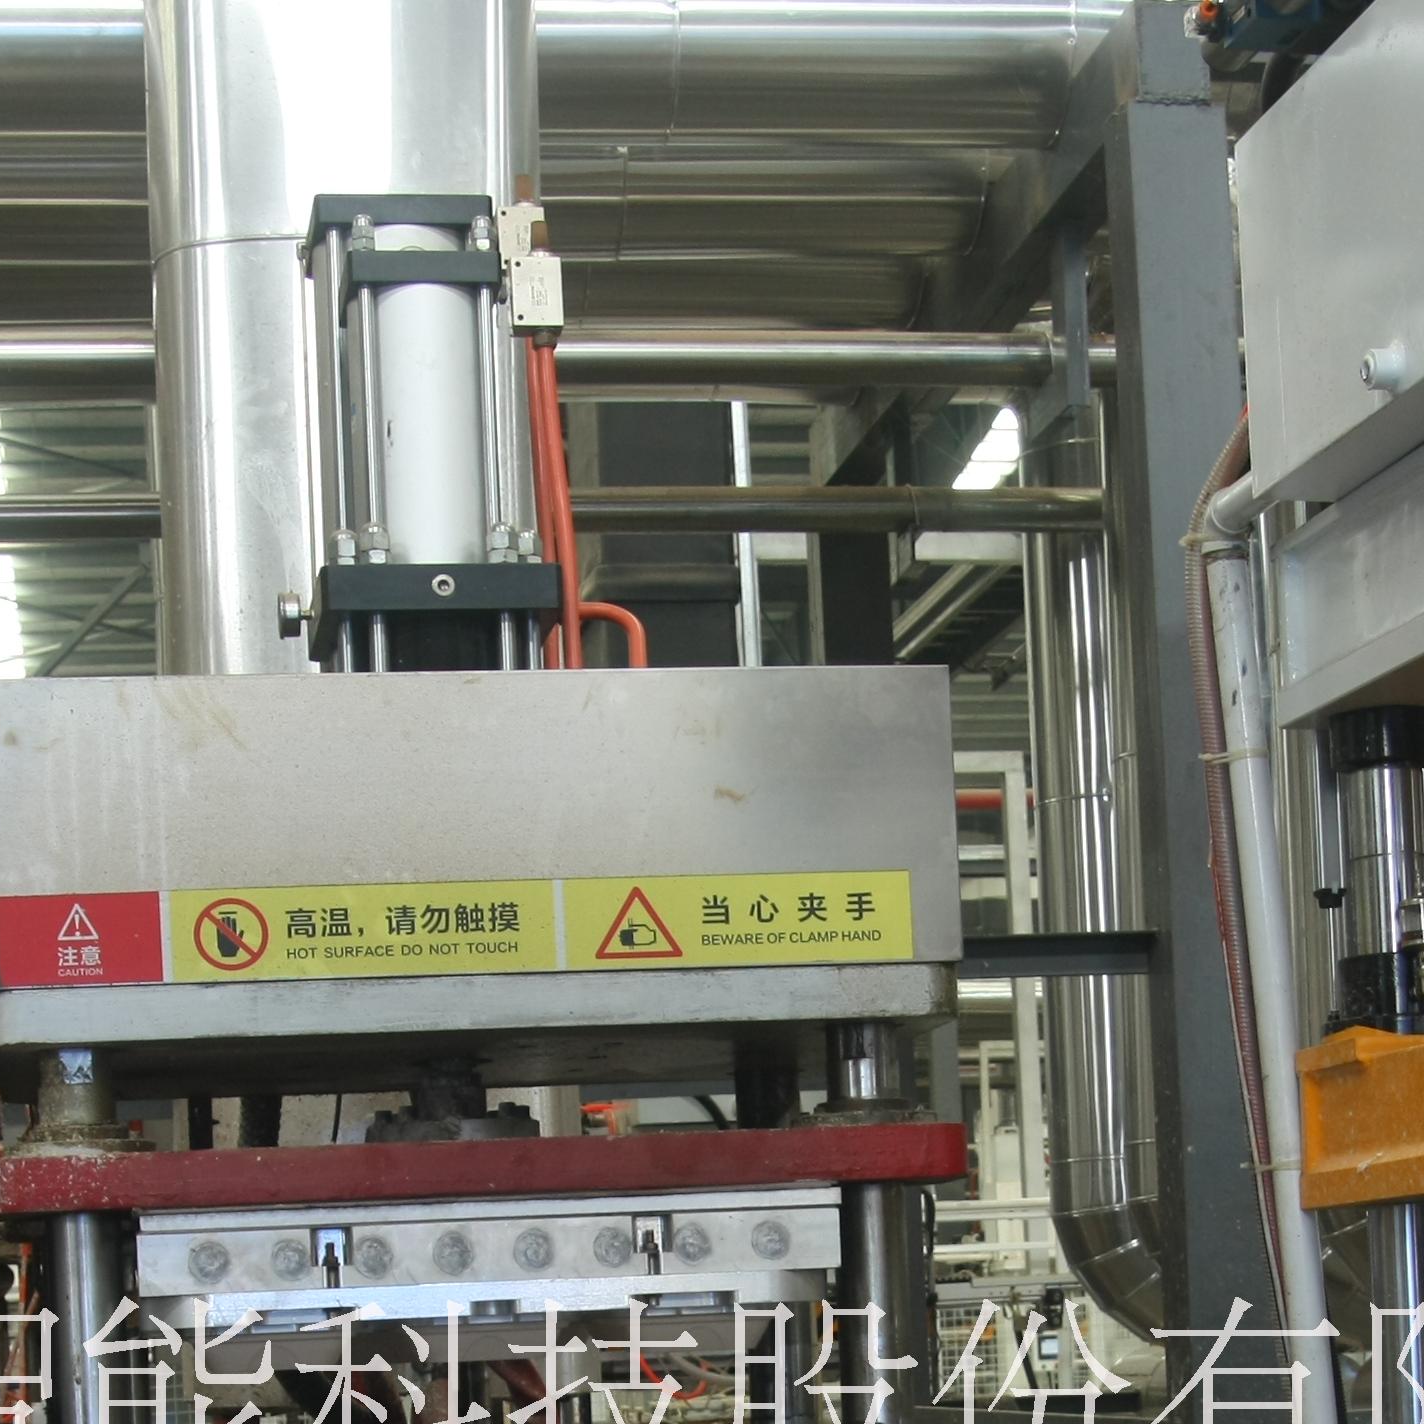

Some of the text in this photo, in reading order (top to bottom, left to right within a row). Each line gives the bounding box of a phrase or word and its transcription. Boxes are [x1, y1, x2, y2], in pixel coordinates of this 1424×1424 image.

[701, 929, 882, 946] BEWARE OF CLAMP HAND
[57, 945, 102, 967] 注意
[285, 941, 519, 960] HOT SURFACE DO NOT TOUCH
[57, 967, 104, 977] CAUTION
